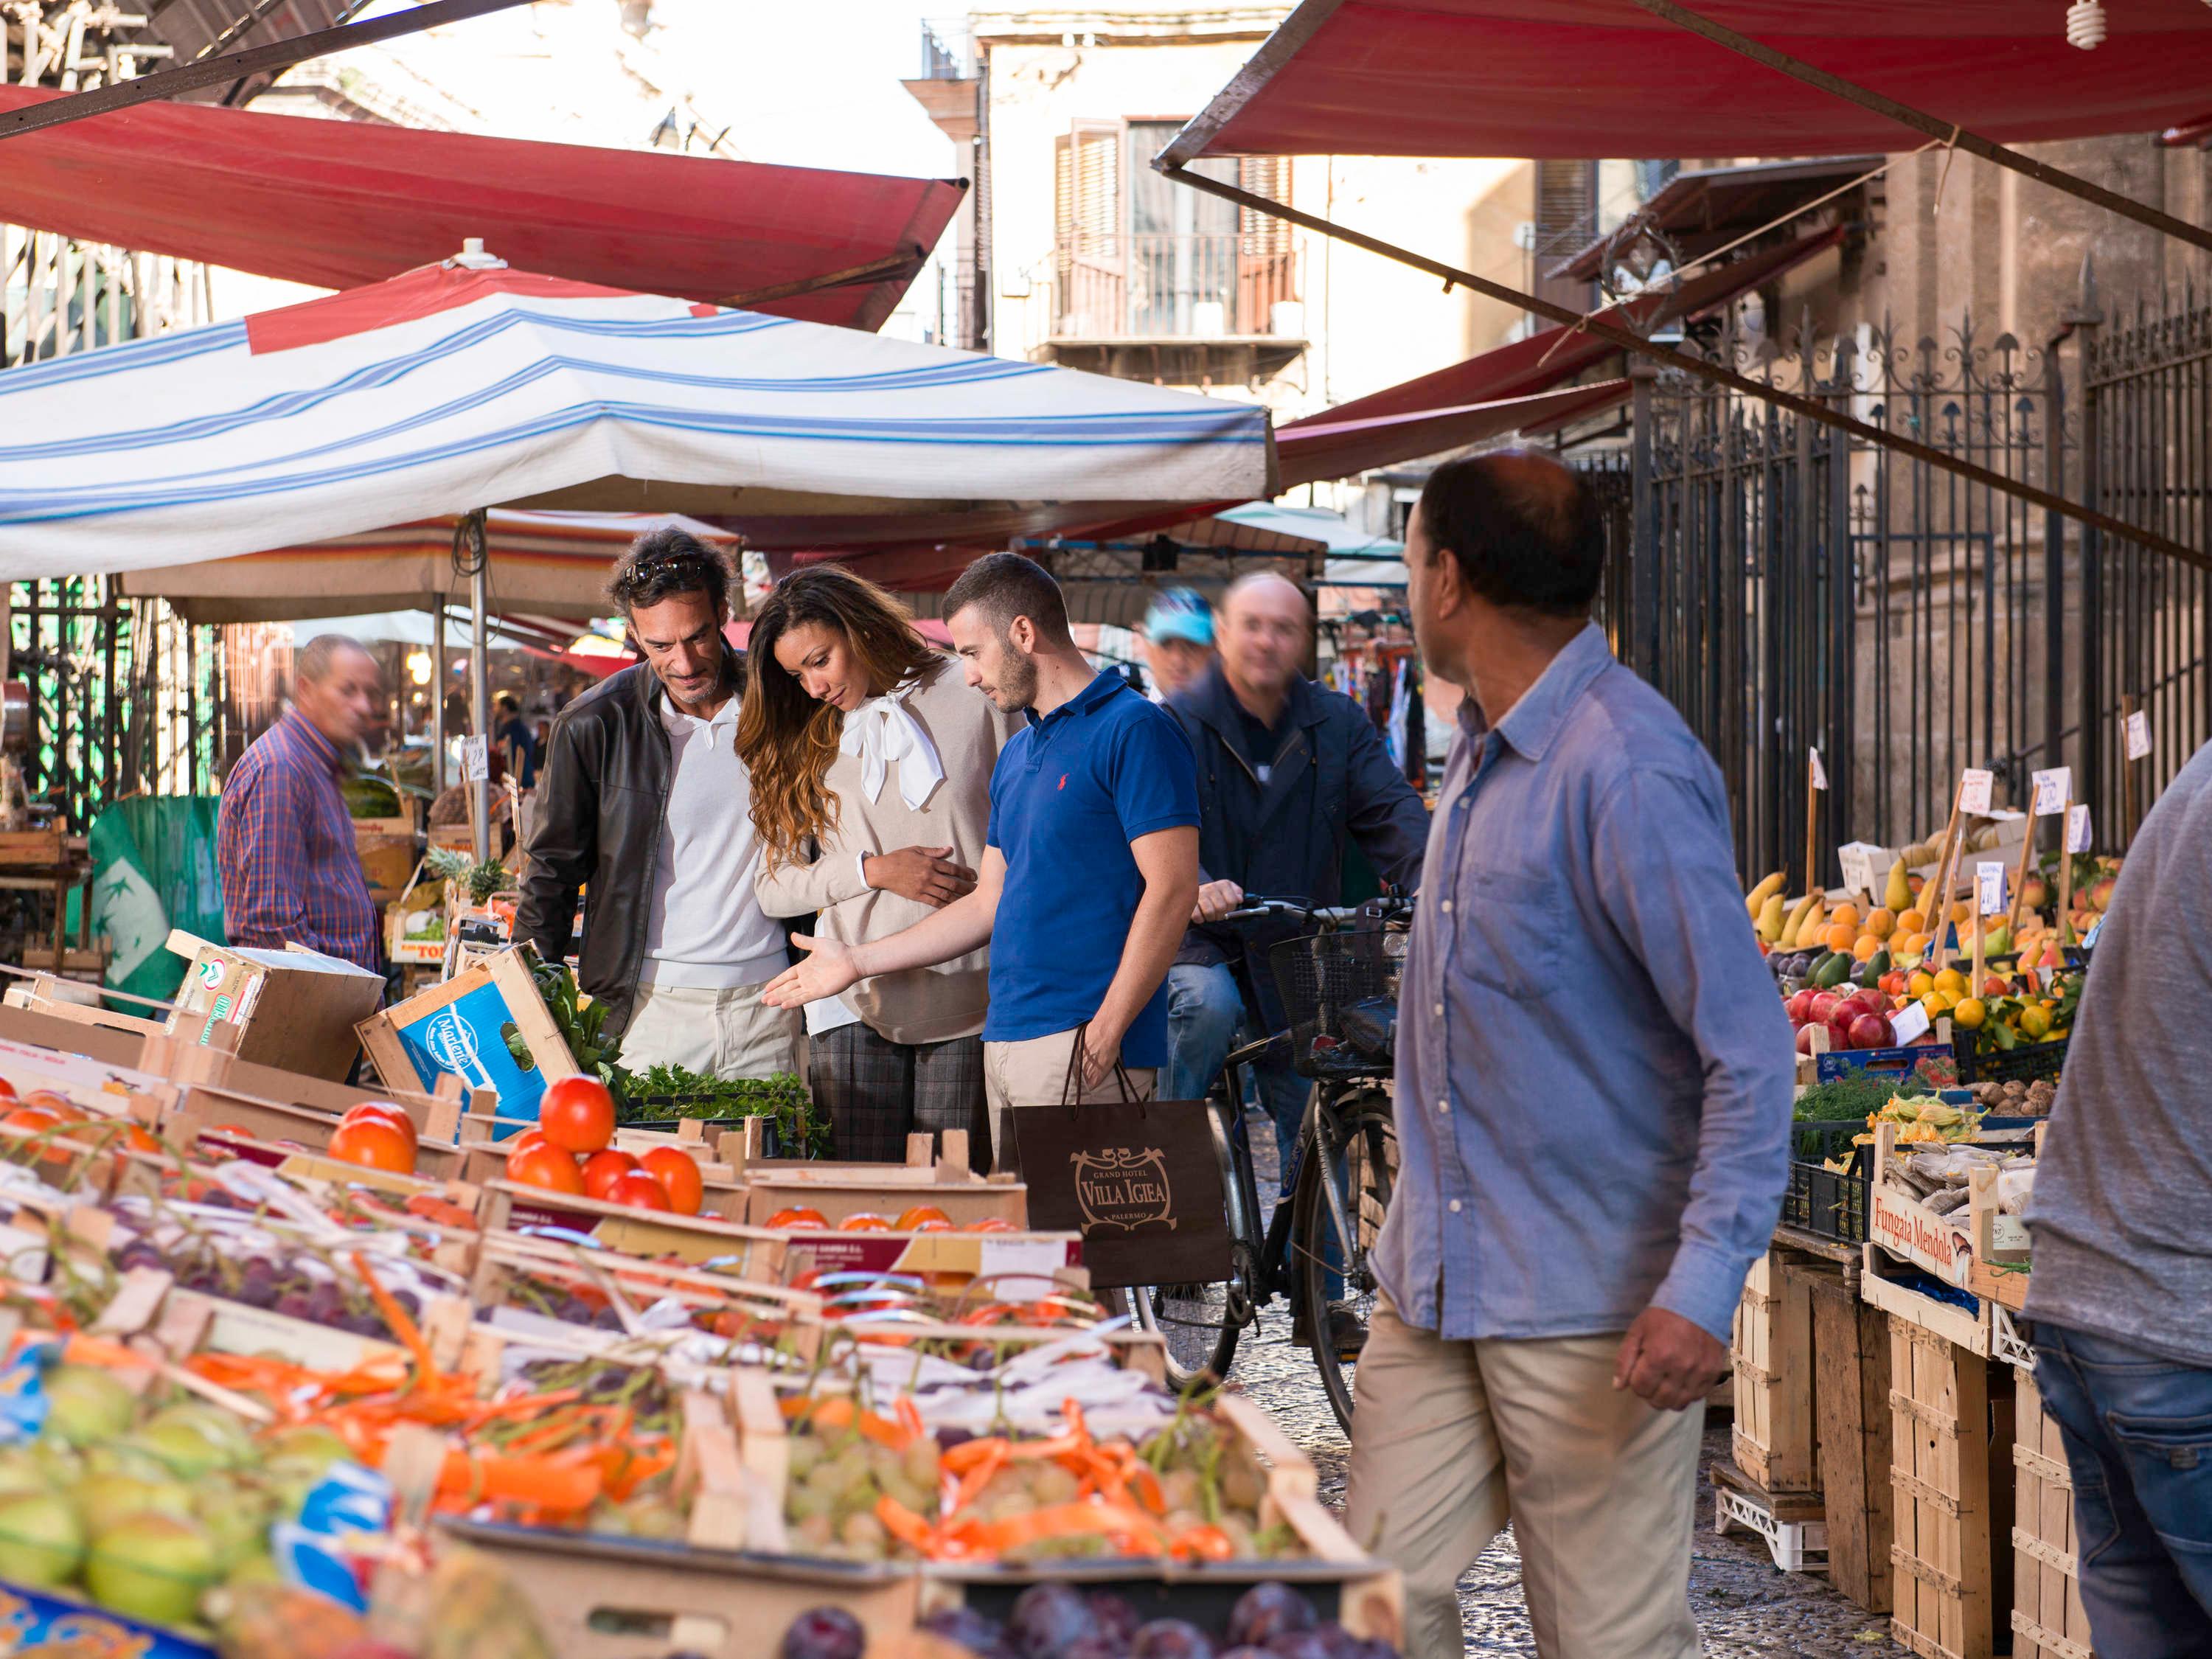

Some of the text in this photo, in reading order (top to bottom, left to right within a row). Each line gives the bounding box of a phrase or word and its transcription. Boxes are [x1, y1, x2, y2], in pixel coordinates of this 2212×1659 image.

[437, 1018, 468, 1065] Marlene
[1093, 1171, 1121, 1179] GRAND
[1080, 1179, 1166, 1207] VILLA IGIEA
[1111, 1212, 1147, 1220] PALERMO
[1875, 1197, 1912, 1249] Fungaia
[1913, 1215, 1952, 1267] Mendola
